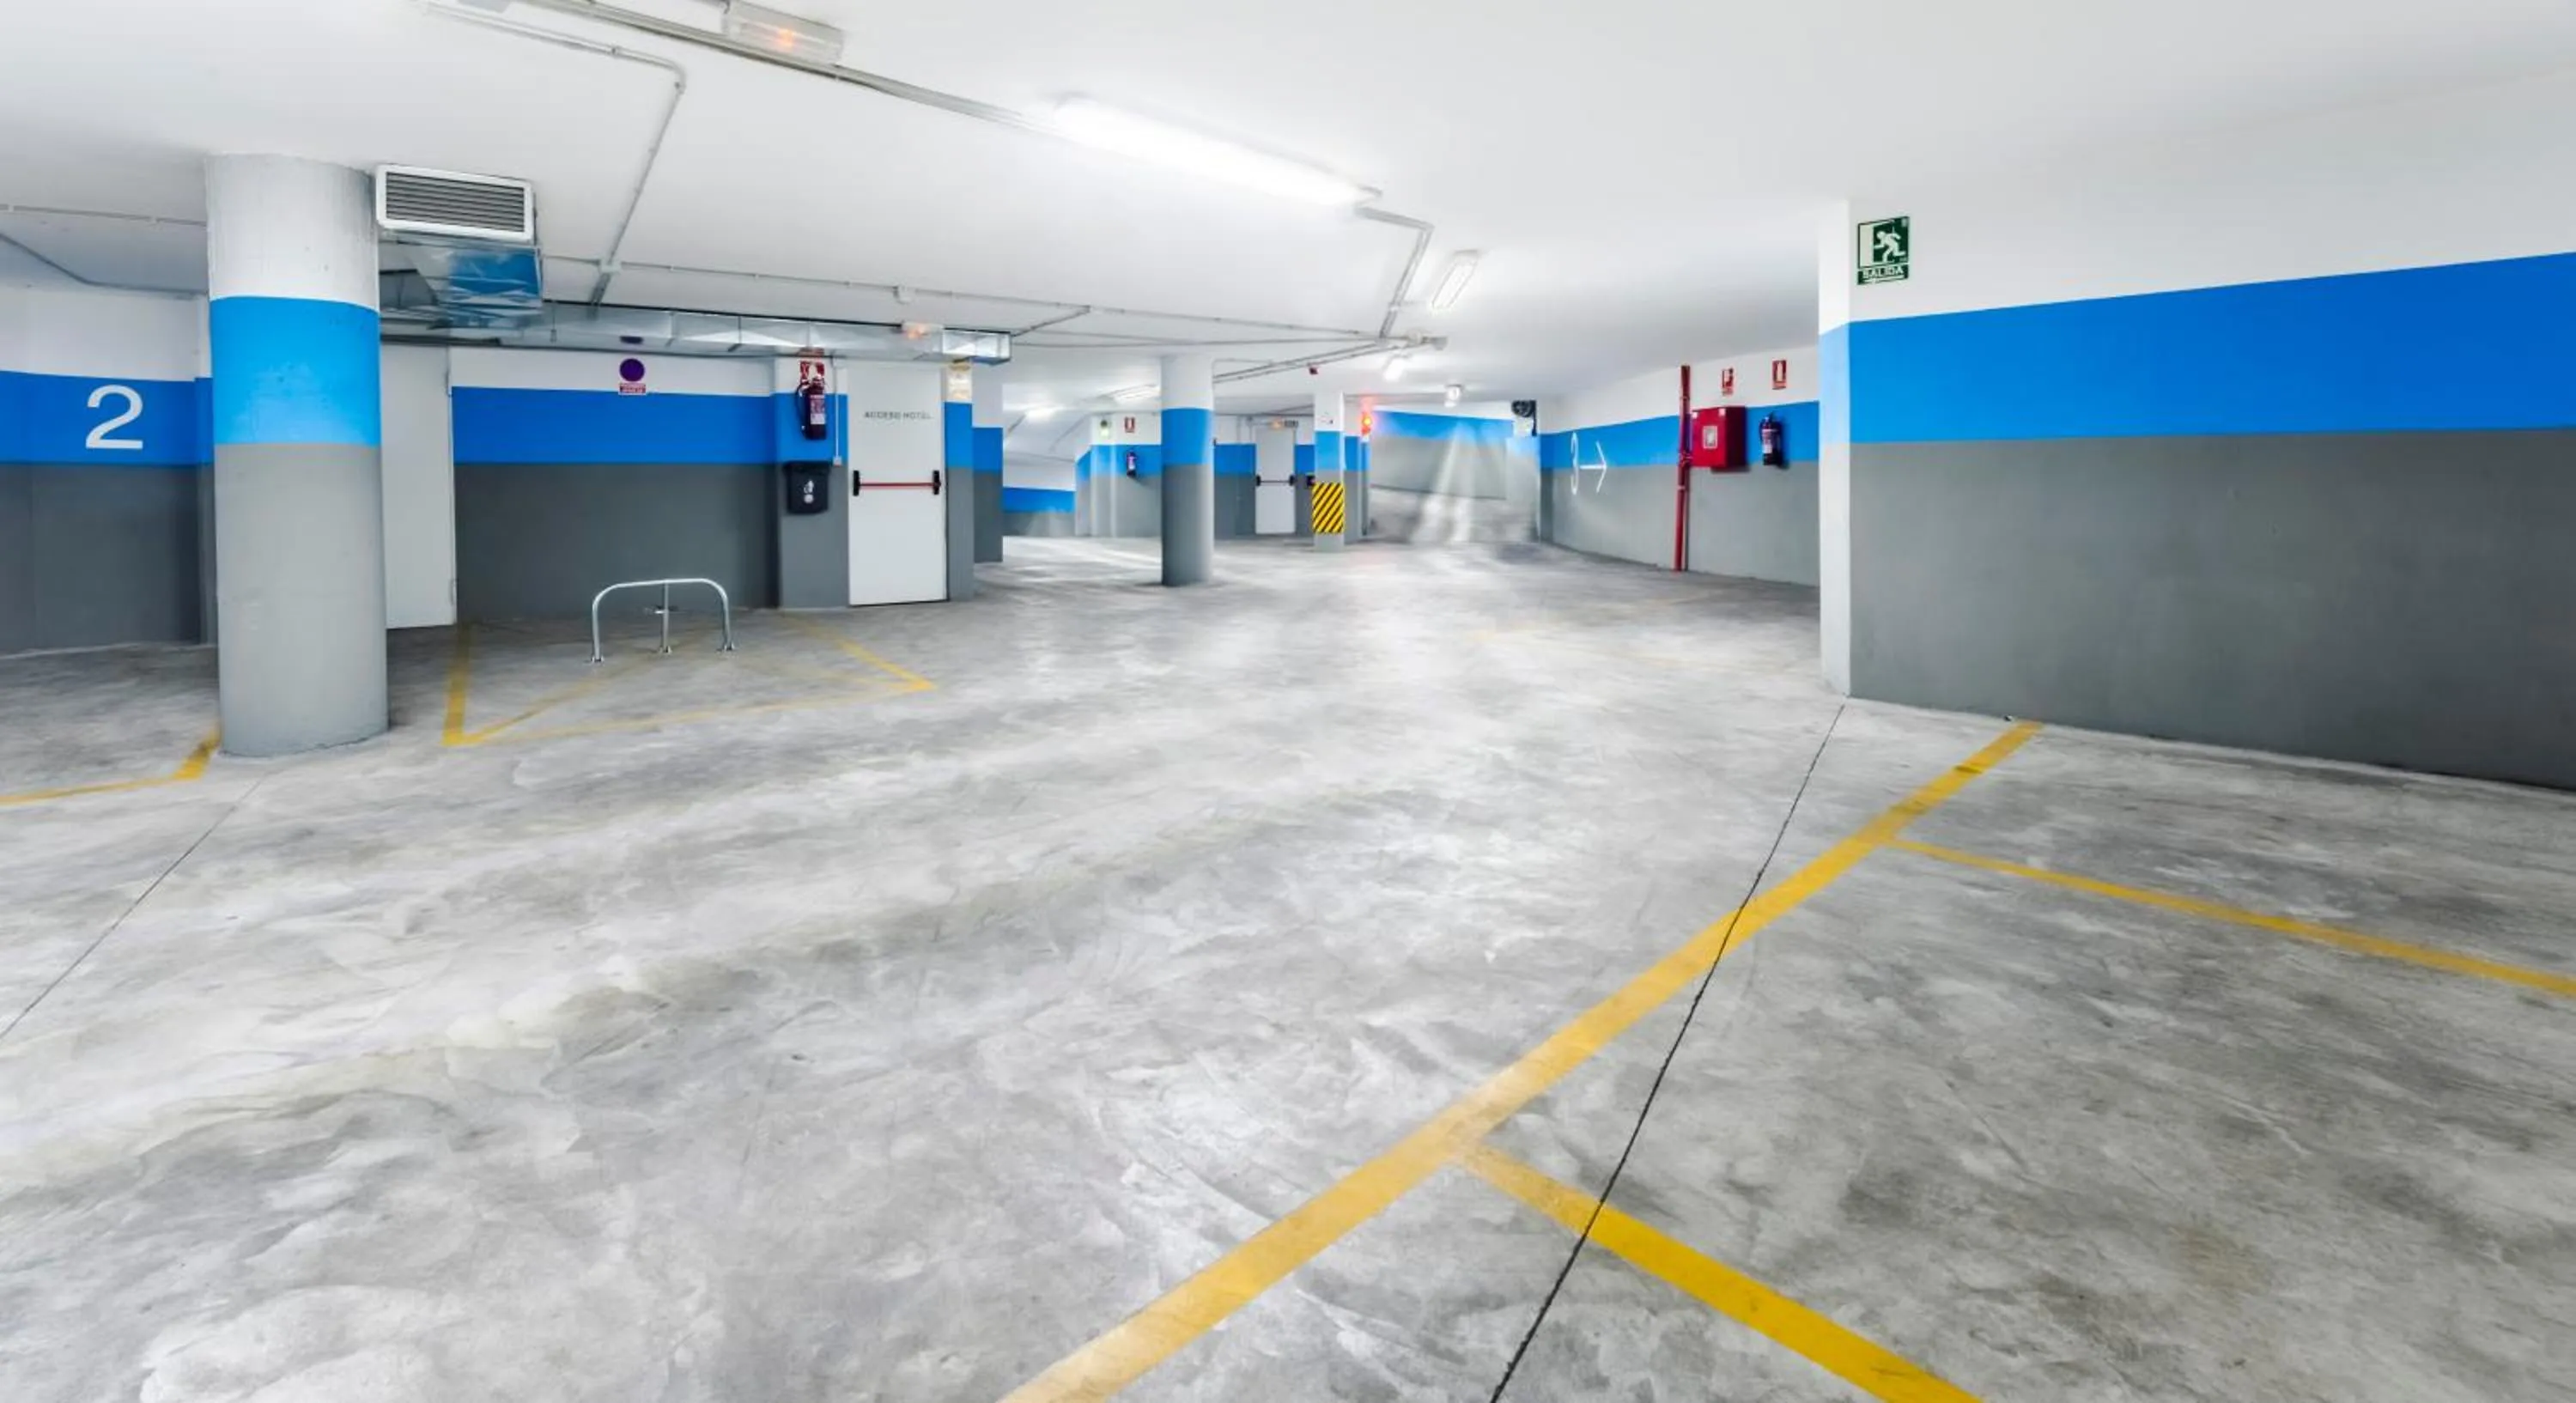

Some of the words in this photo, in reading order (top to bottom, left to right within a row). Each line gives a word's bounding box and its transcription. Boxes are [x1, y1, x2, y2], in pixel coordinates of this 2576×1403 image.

[1862, 265, 1905, 279] SALIDA
[85, 385, 143, 450] 2
[903, 411, 933, 420] HOTEL
